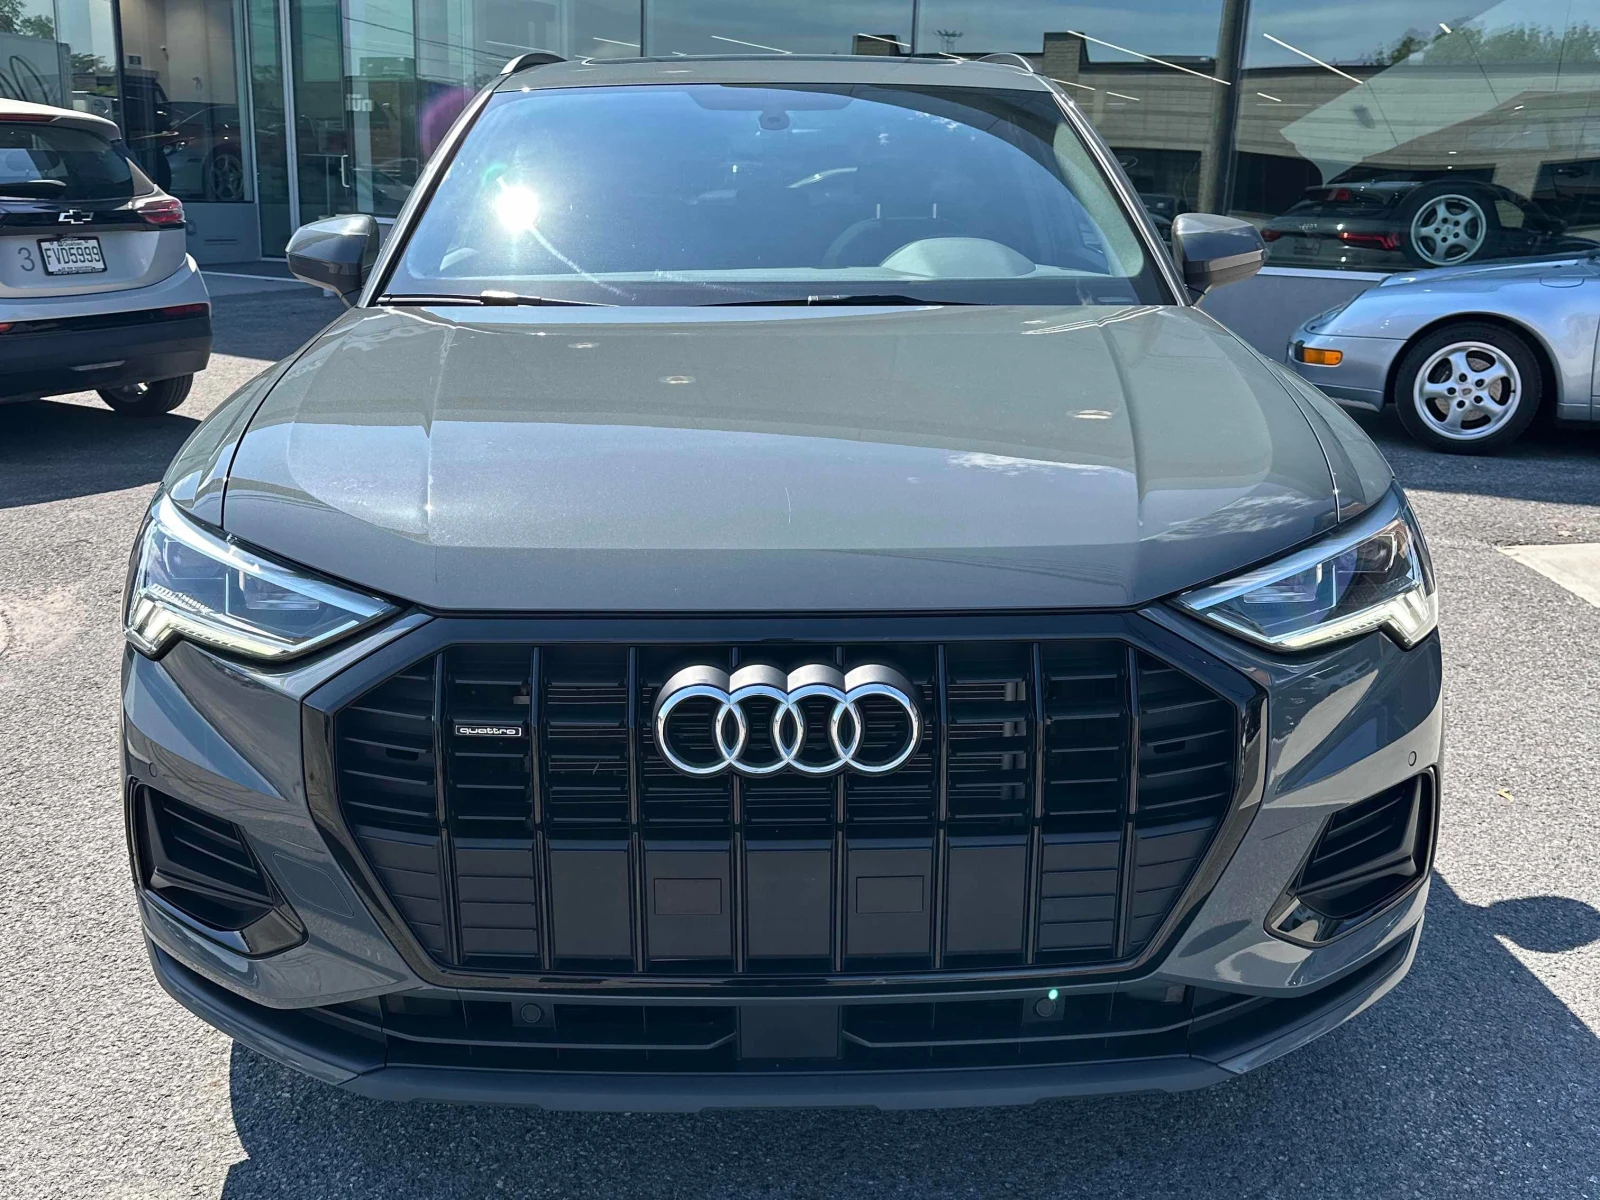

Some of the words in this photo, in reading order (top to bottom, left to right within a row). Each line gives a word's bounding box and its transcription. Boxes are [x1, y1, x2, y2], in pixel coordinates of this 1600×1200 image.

[17, 247, 36, 272] 3
[44, 246, 101, 265] FVD5999
[460, 727, 516, 735] quattro
